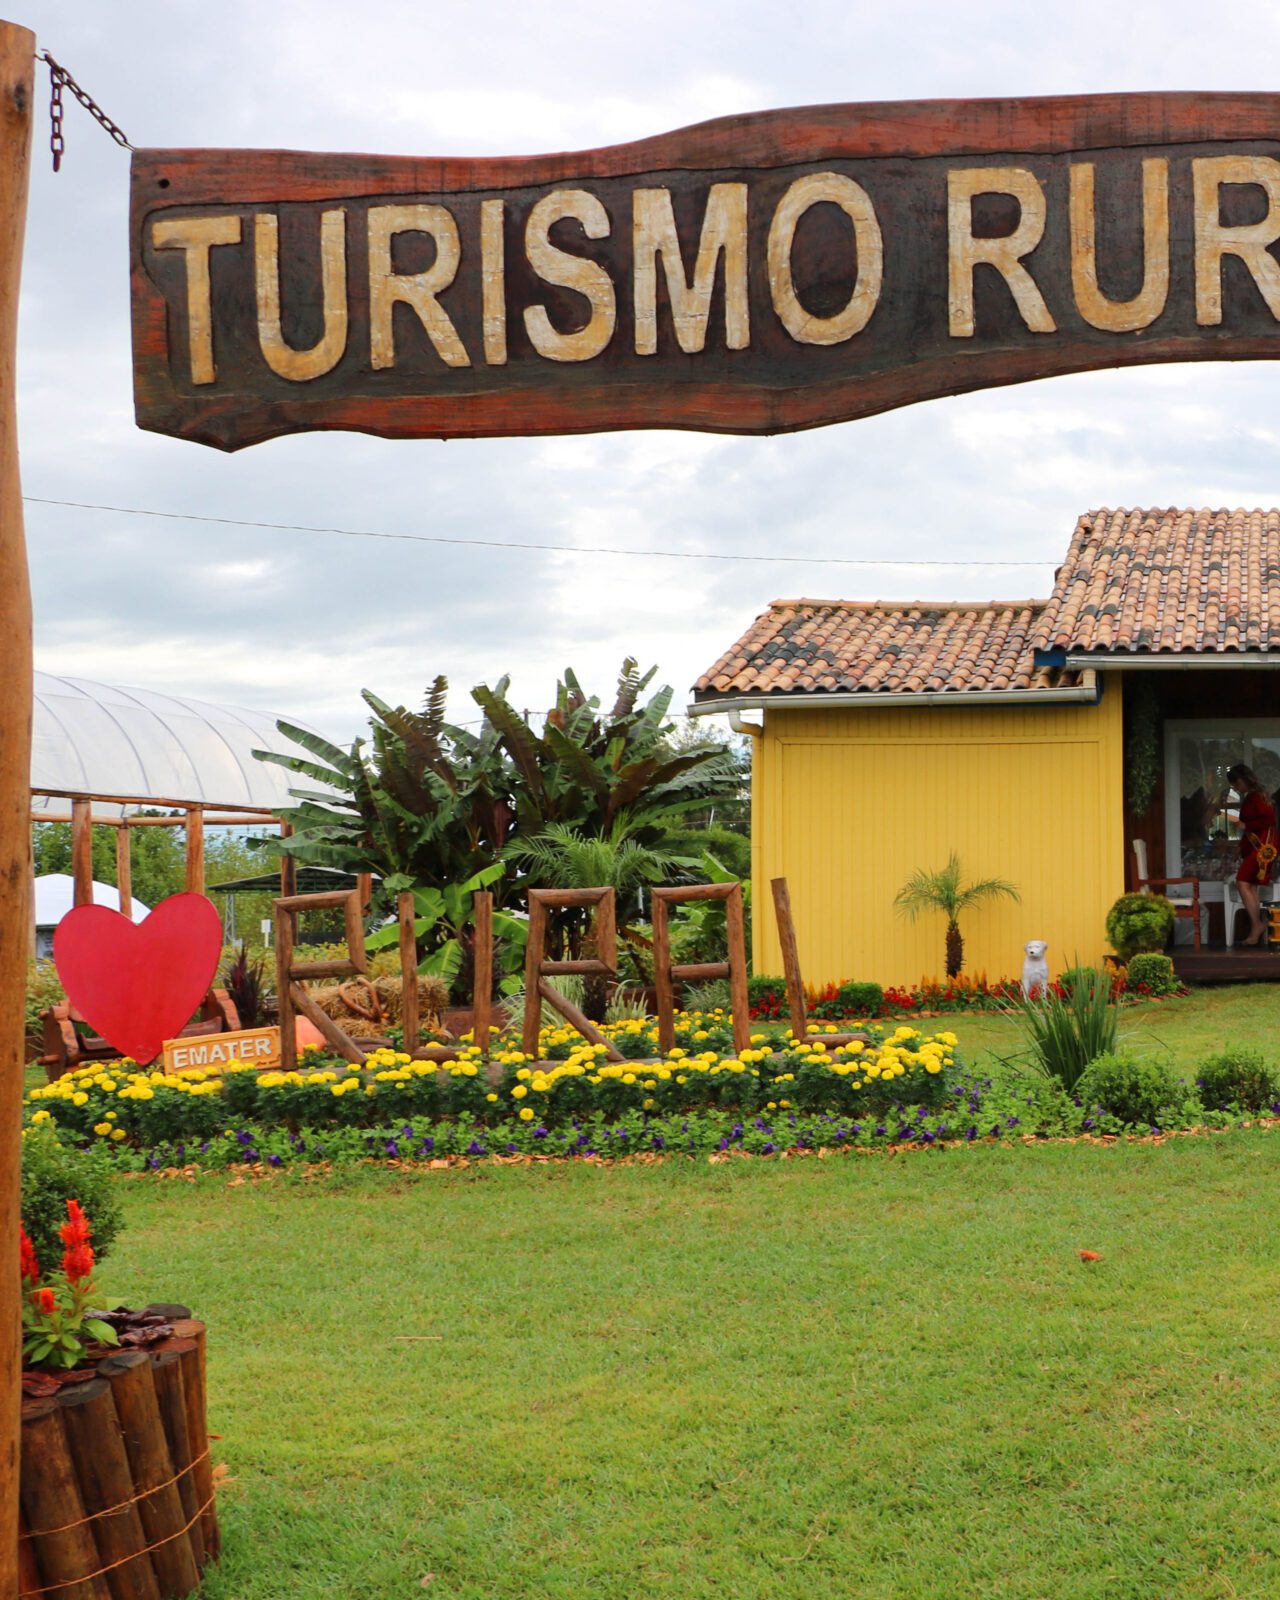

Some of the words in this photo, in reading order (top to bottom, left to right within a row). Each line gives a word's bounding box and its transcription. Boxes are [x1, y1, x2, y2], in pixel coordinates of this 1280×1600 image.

[152, 171, 884, 385] TURISMO
[173, 1038, 272, 1069] EMATER
[274, 877, 870, 1071] RURAL
